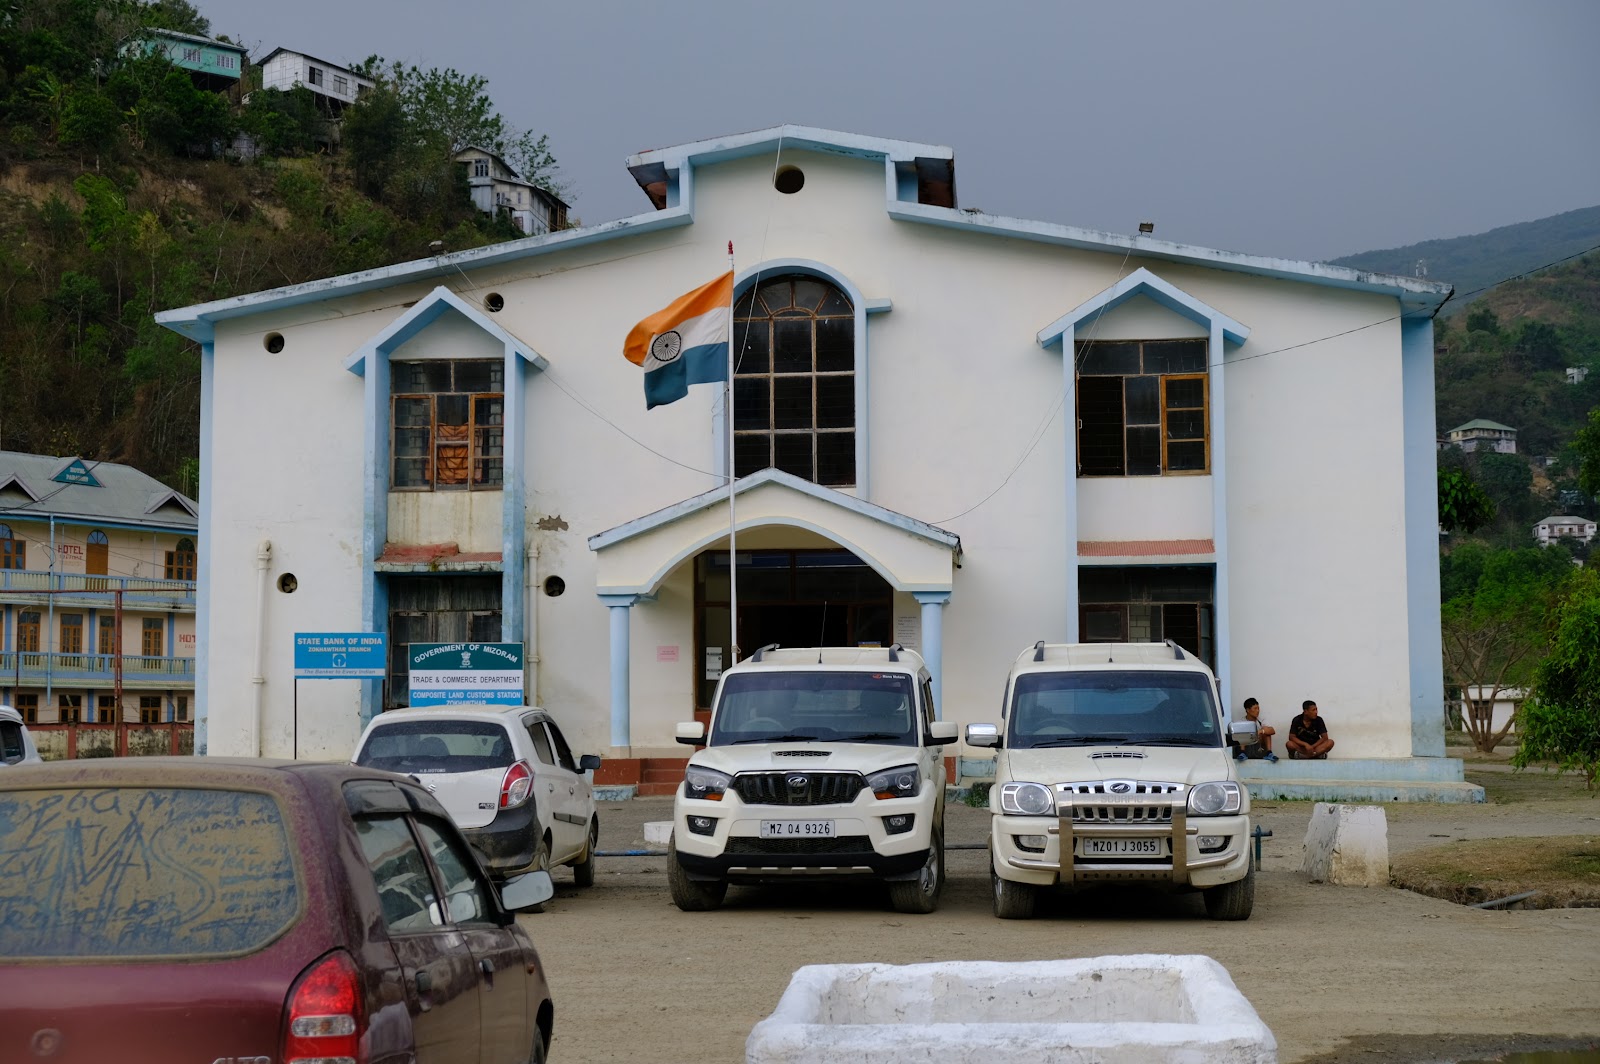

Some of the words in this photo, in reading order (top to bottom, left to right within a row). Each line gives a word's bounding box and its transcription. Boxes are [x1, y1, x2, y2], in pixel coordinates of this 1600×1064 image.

[58, 544, 83, 554] HOTEL
[414, 644, 466, 663] GOVERNMENT
[483, 646, 518, 663] MIZORAM
[770, 824, 782, 834] MZ
[788, 824, 800, 834] 04
[806, 824, 830, 834] 9326
